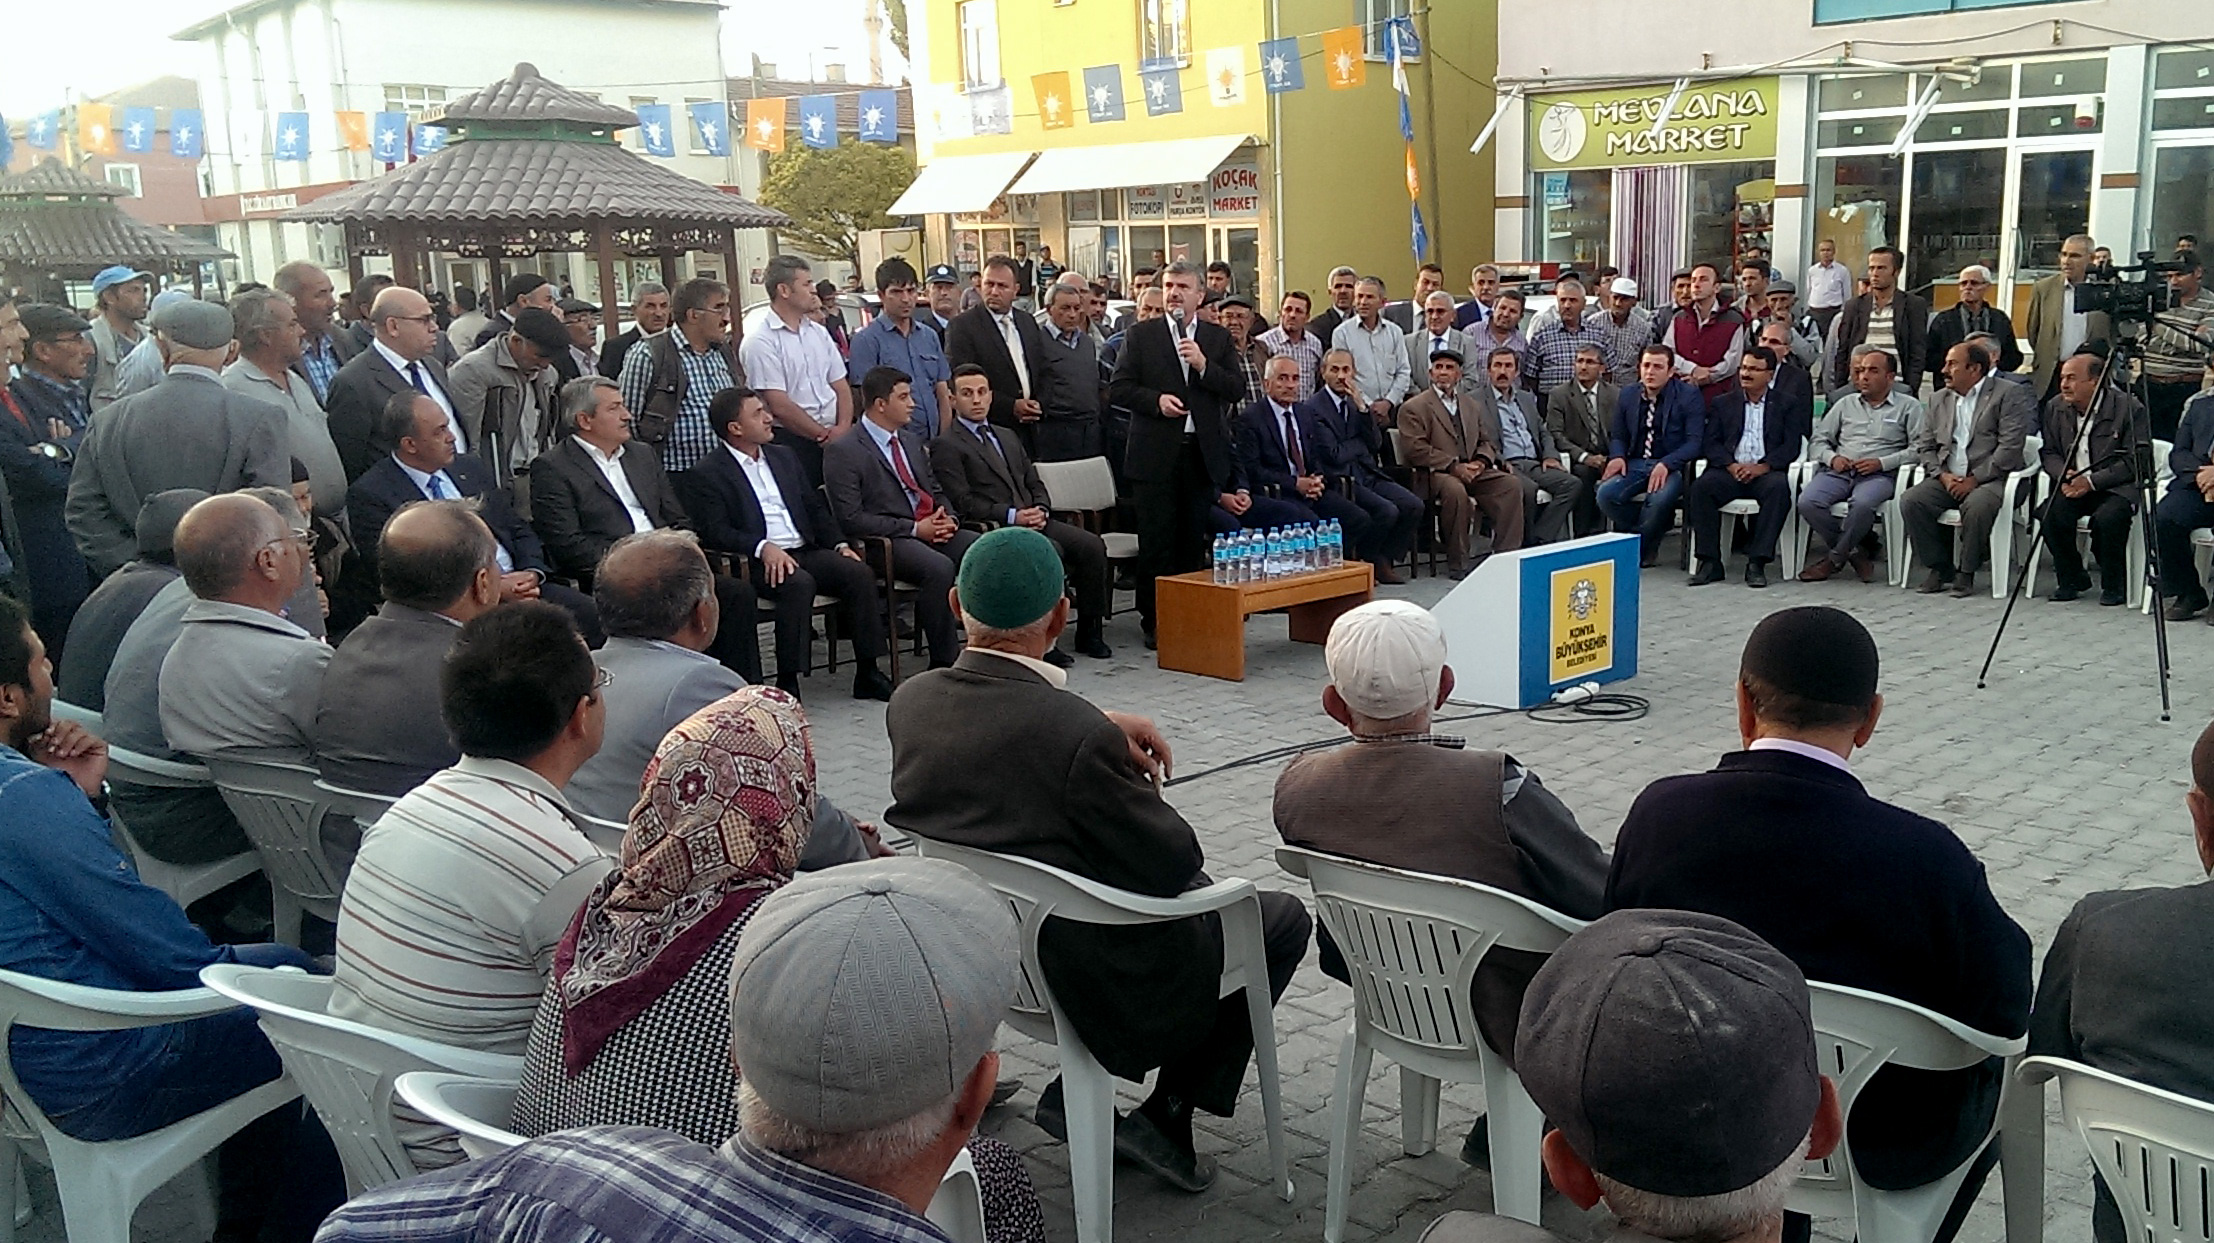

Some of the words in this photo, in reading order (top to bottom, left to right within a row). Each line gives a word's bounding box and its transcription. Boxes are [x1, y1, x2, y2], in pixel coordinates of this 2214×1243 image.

[1607, 122, 1750, 155] MARKET
[1212, 169, 1258, 193] KOÇAK
[1212, 196, 1258, 212] MARKET
[1569, 624, 1595, 639] KONYA
